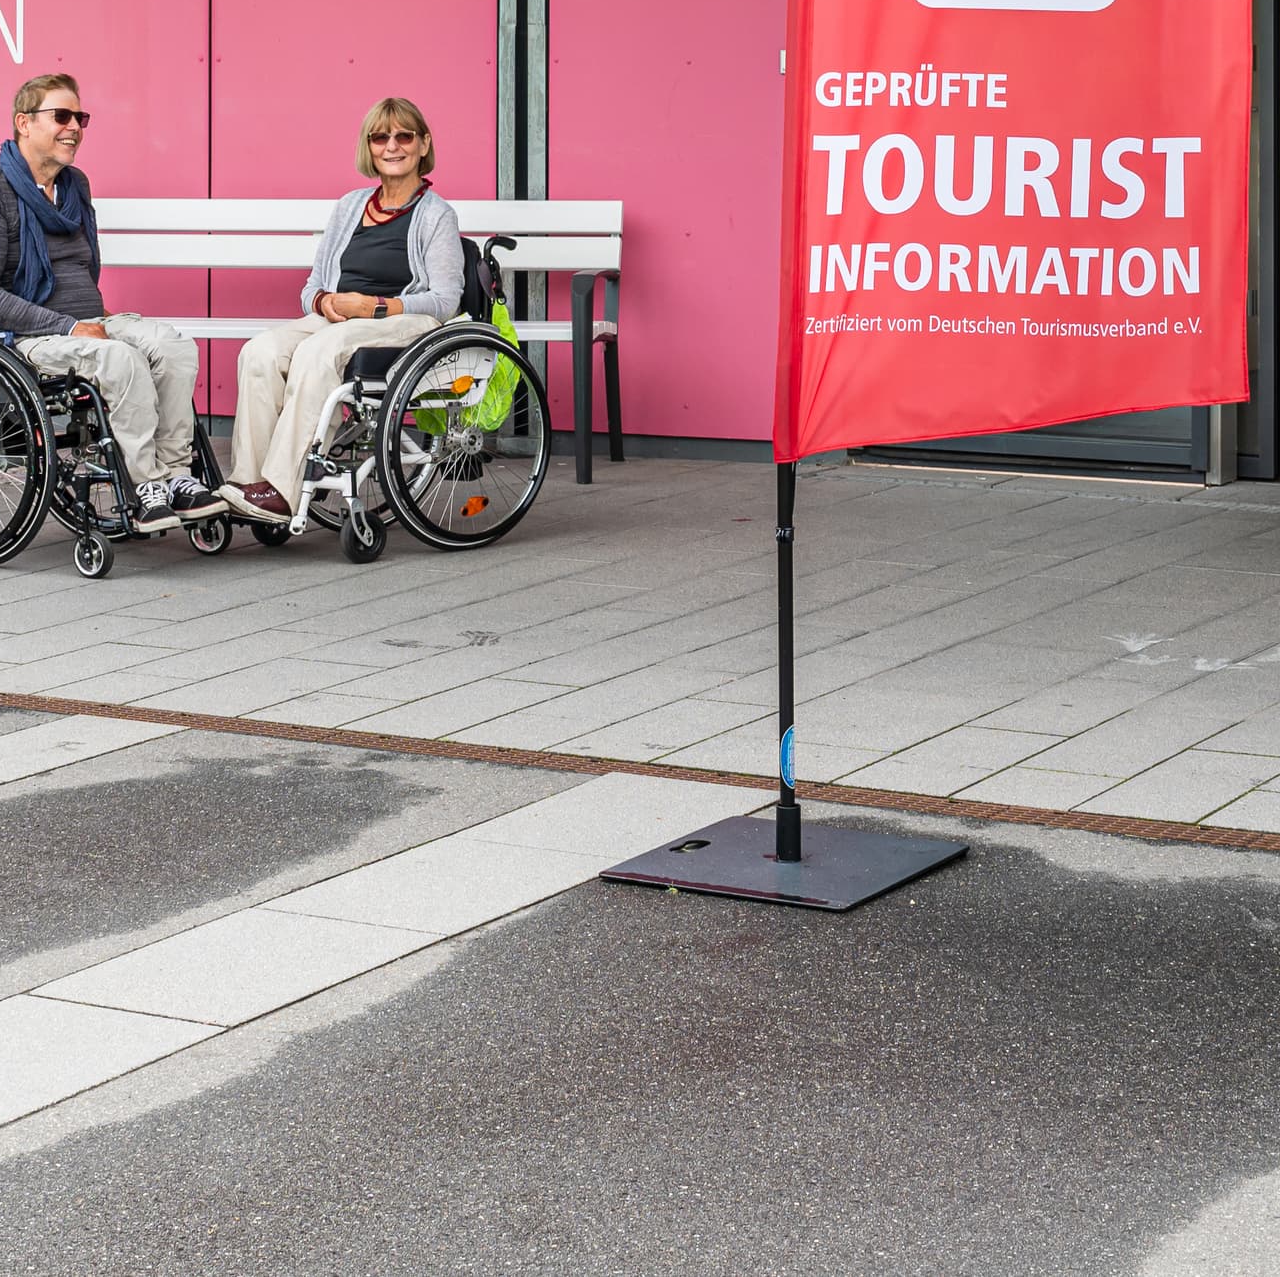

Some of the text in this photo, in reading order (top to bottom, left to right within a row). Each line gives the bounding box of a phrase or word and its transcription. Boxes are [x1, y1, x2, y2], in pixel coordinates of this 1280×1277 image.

[815, 64, 1008, 108] GEPRÜFTE
[812, 133, 1202, 220] TOURIST
[808, 242, 1201, 297] INFORMATION
[805, 314, 1203, 338] Zertifiziert vom Deutschen Tourismusverband e.V.
